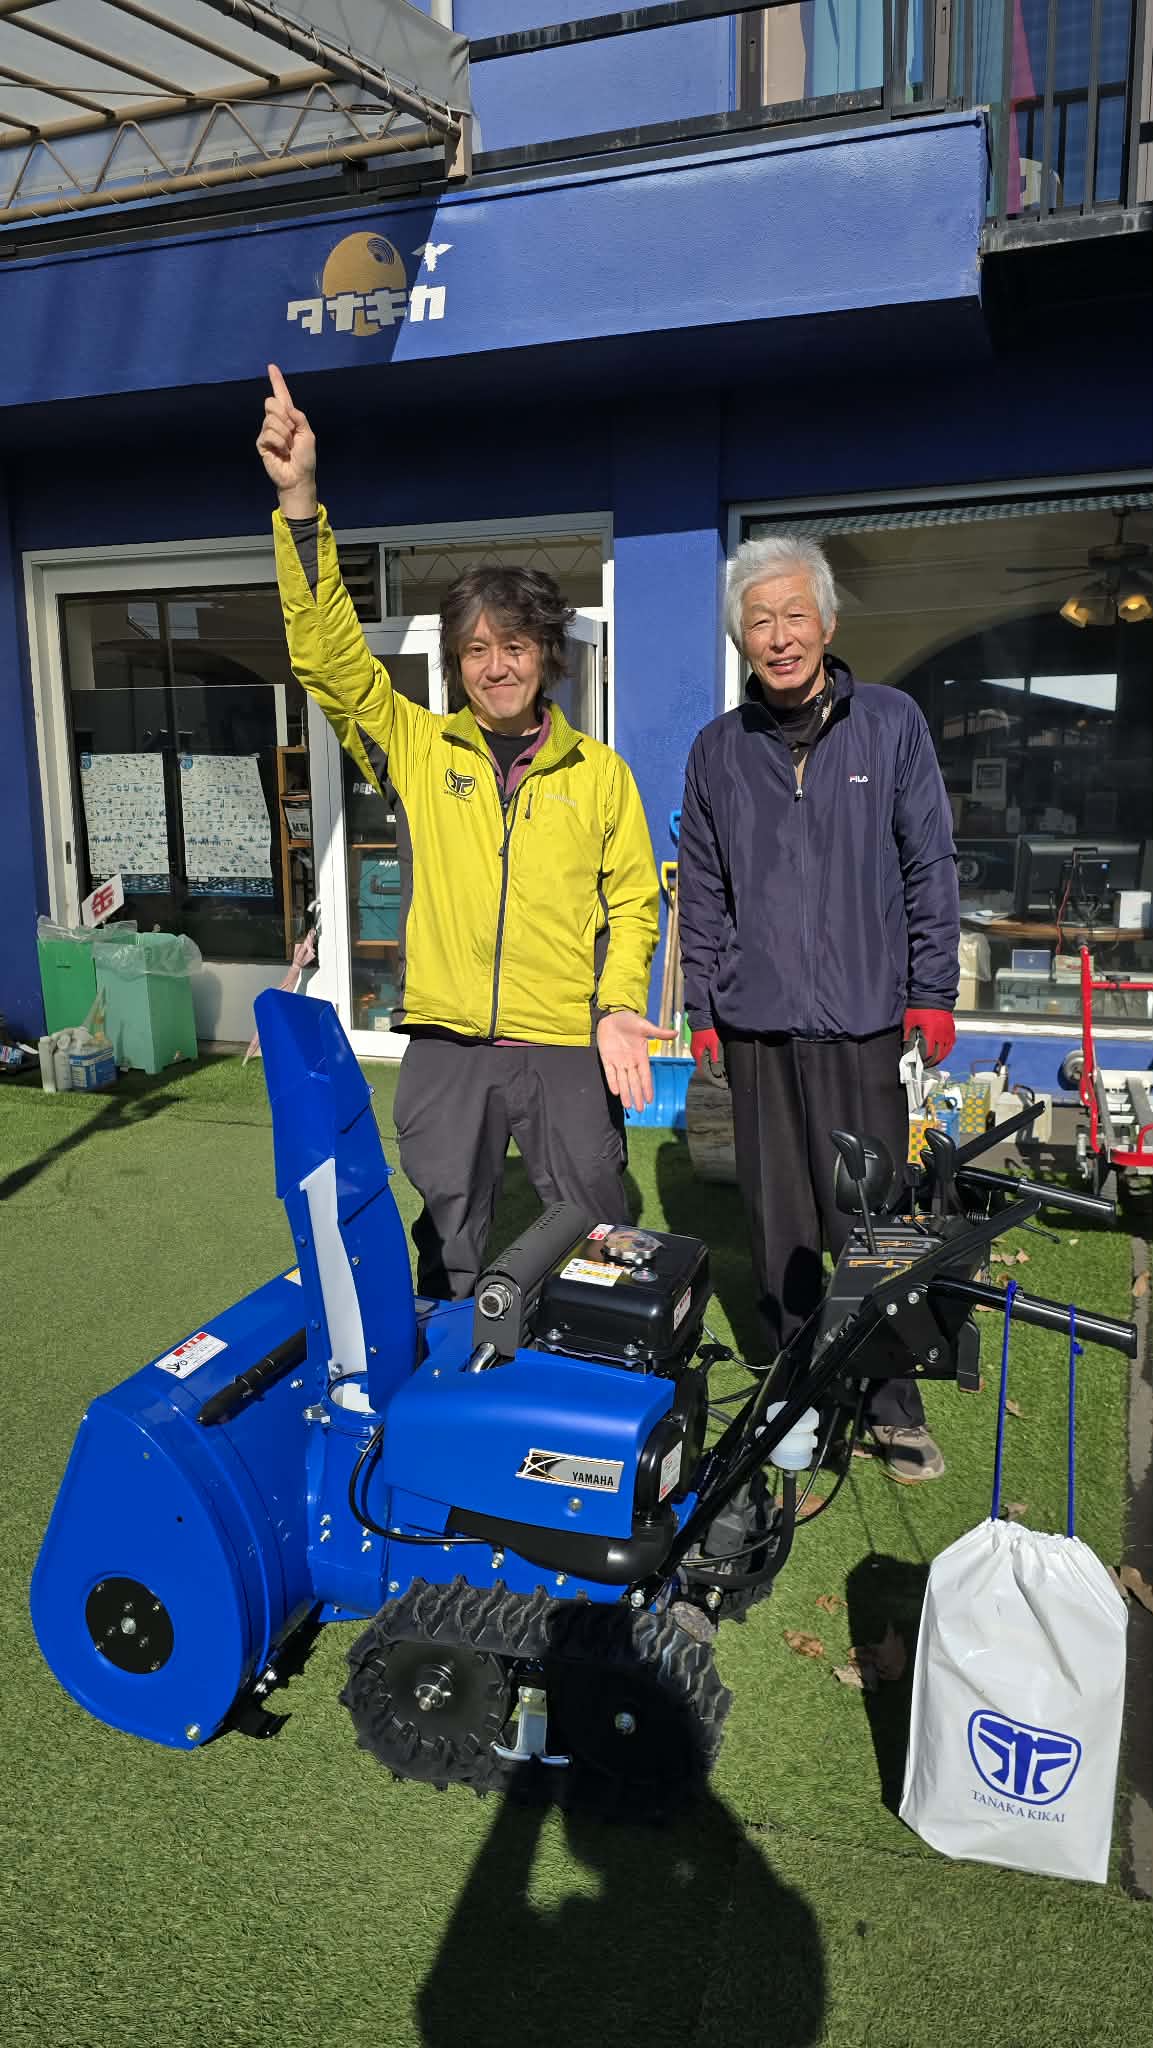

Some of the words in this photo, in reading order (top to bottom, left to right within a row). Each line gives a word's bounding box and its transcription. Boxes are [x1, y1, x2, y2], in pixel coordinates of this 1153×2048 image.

[287, 285, 446, 335] タナキカ
[849, 774, 869, 783] FILA
[573, 1471, 614, 1487] YAMAHA
[971, 1790, 1025, 1818] TANAKA
[1027, 1809, 1065, 1823] KIKAI
